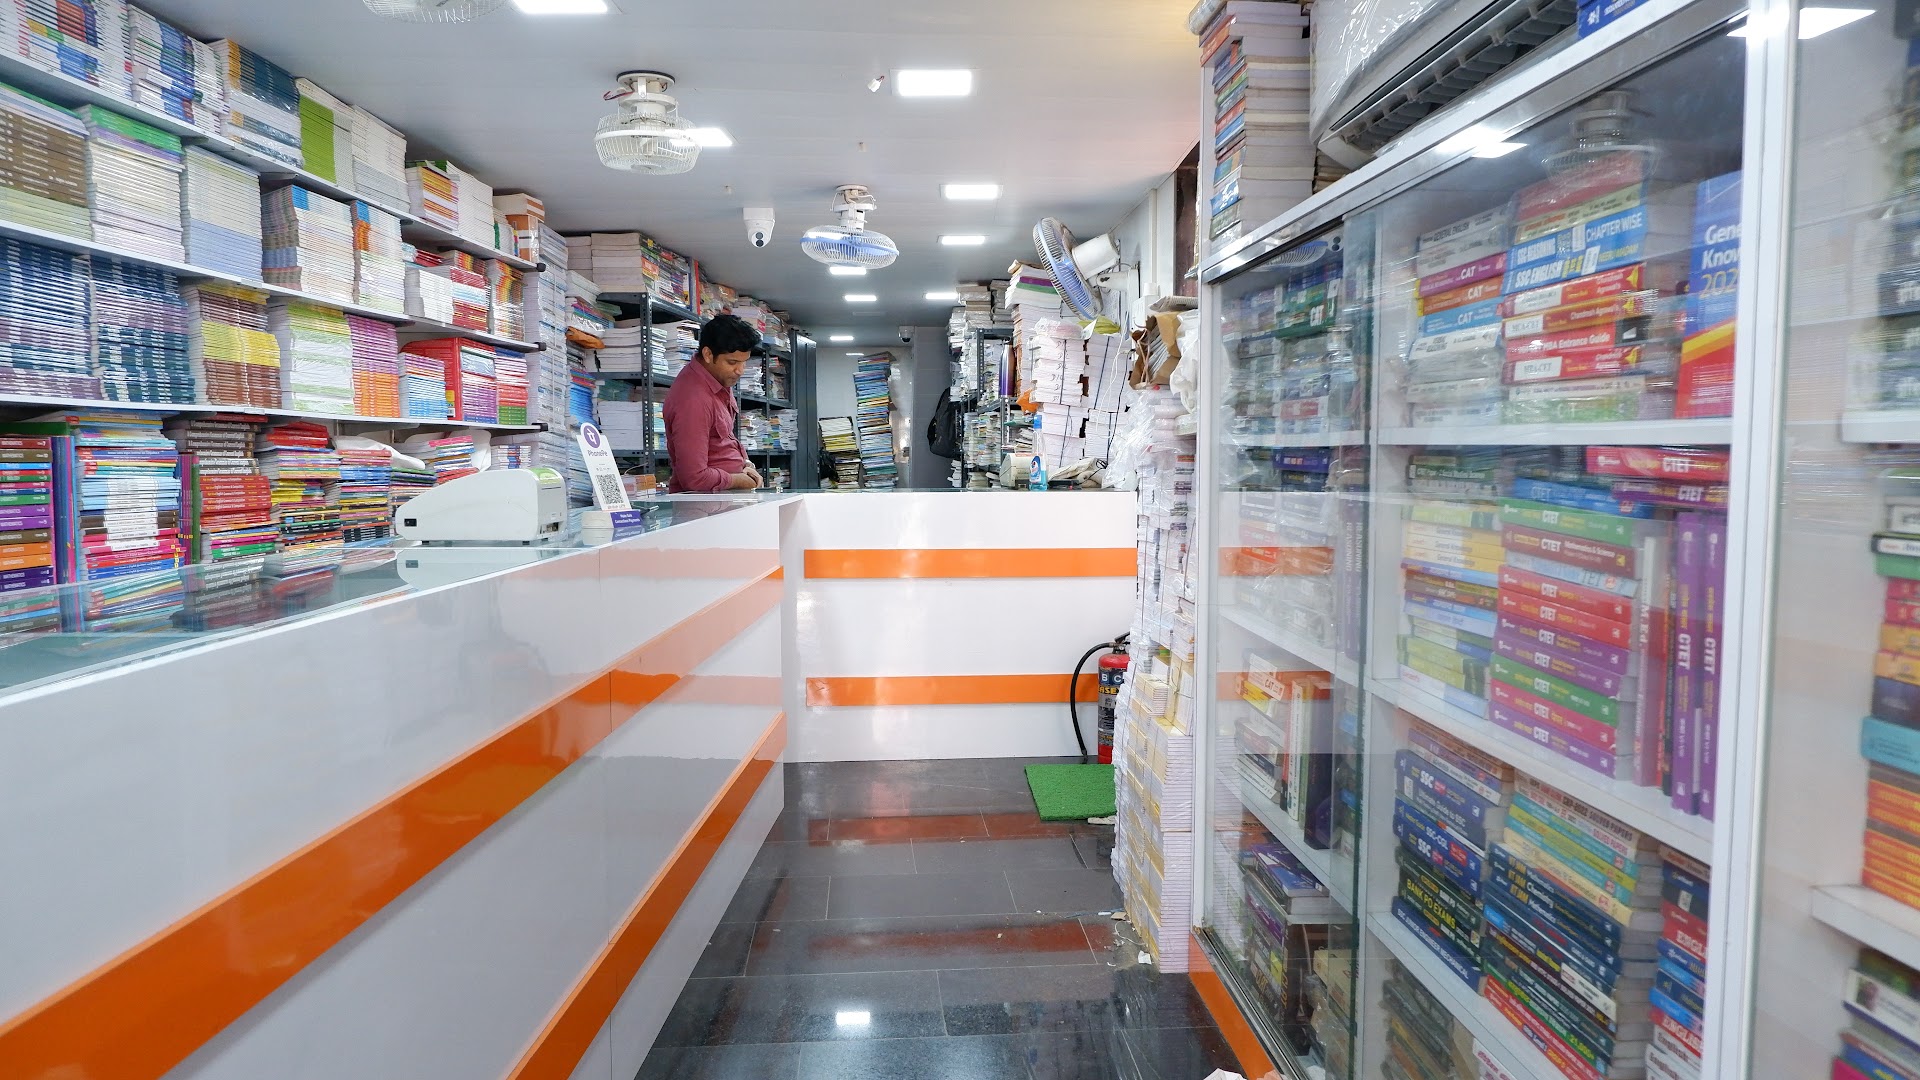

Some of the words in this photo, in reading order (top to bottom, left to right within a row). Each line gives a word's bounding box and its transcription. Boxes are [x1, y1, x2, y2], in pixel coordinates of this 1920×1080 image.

[1586, 219, 1620, 242] CHAPTER
[1621, 211, 1643, 232] WISE
[1704, 222, 1742, 246] Gene
[1701, 248, 1740, 271] Know
[1460, 265, 1476, 280] CAT
[1530, 259, 1565, 285] ENGLISH
[1699, 267, 1739, 298] 202
[1467, 285, 1483, 300] CAT
[1457, 311, 1474, 326] CAT
[1589, 332, 1611, 344] Guide
[587, 449, 608, 457] PhonePe
[1662, 456, 1692, 473] CTET
[1541, 538, 1562, 553] CTET
[1678, 633, 1691, 670] CTET
[1704, 637, 1716, 675] CTET
[1102, 673, 1108, 682] B
[1113, 675, 1122, 683] C
[1420, 770, 1434, 789] SSC
[1418, 838, 1431, 857] SSC
[1407, 878, 1424, 901] BANK
[1423, 895, 1433, 910] PO
[1433, 903, 1456, 930] EXAMS
[1676, 929, 1707, 959] ENGL
